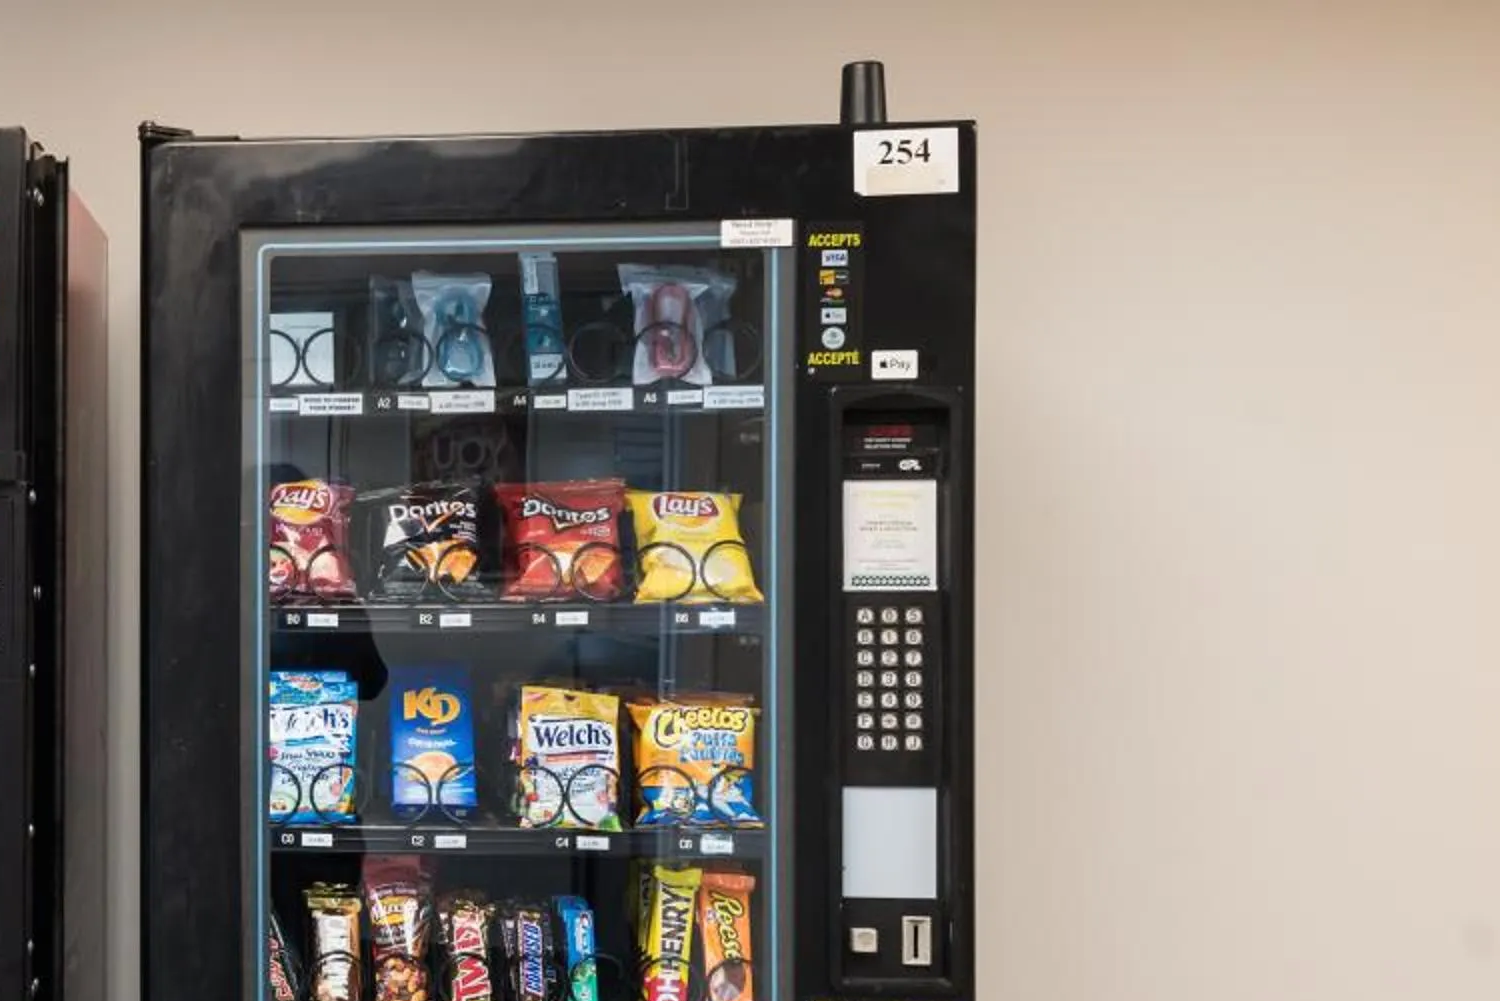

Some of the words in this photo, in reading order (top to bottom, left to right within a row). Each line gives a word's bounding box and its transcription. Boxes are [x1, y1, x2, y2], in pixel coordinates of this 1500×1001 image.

[878, 138, 931, 165] 254
[808, 233, 861, 247] ACCEPTS
[889, 359, 911, 372] Pay
[388, 500, 476, 523] Doritos
[403, 687, 460, 726] KD
[533, 722, 613, 748] Welch's
[655, 707, 748, 747] Cheetos
[659, 887, 690, 974] HENRY
